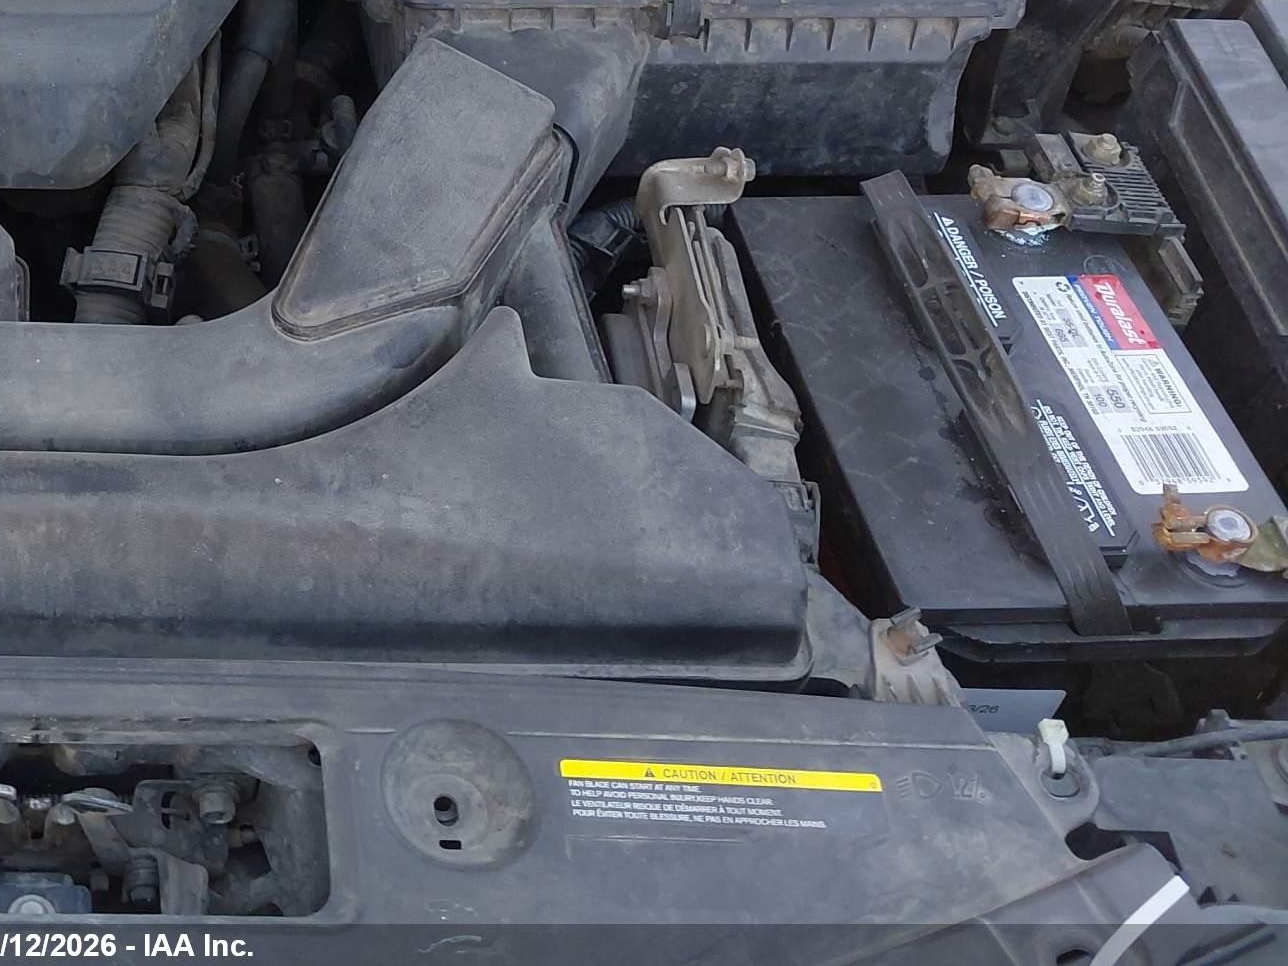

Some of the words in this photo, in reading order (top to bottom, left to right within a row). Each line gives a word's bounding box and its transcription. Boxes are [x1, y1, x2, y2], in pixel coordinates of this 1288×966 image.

[945, 226, 979, 269] DANGER
[973, 278, 1007, 320] POISON
[1072, 284, 1097, 313] PROVEN
[1092, 315, 1114, 341] TOUGH
[1092, 282, 1147, 344] Duralast
[1092, 393, 1108, 407] 100
[1105, 389, 1127, 408] 550
[569, 779, 584, 787] FAN
[585, 780, 610, 788] BLADE
[611, 781, 628, 789] CAN
[629, 782, 652, 790] START
[665, 784, 680, 792] ANY
[662, 768, 717, 781] CAUTION
[730, 771, 797, 785] ATTENTION
[582, 789, 602, 797] HELP
[603, 790, 627, 799] AVOID
[627, 791, 669, 801] PERSONAL
[697, 795, 716, 803] KEEP
[718, 796, 745, 804] HANDS
[582, 800, 631, 809] VENTILATEUR
[633, 802, 662, 811] RISQUE
[675, 803, 717, 813] DÉMARRER
[727, 807, 746, 815] TOUT
[573, 809, 595, 817] POUR
[596, 808, 623, 818] ÉVITER
[624, 811, 648, 820] TOUTE
[705, 815, 721, 823] PAS
[734, 817, 784, 826] APPROCHER
[784, 819, 799, 827] LES
